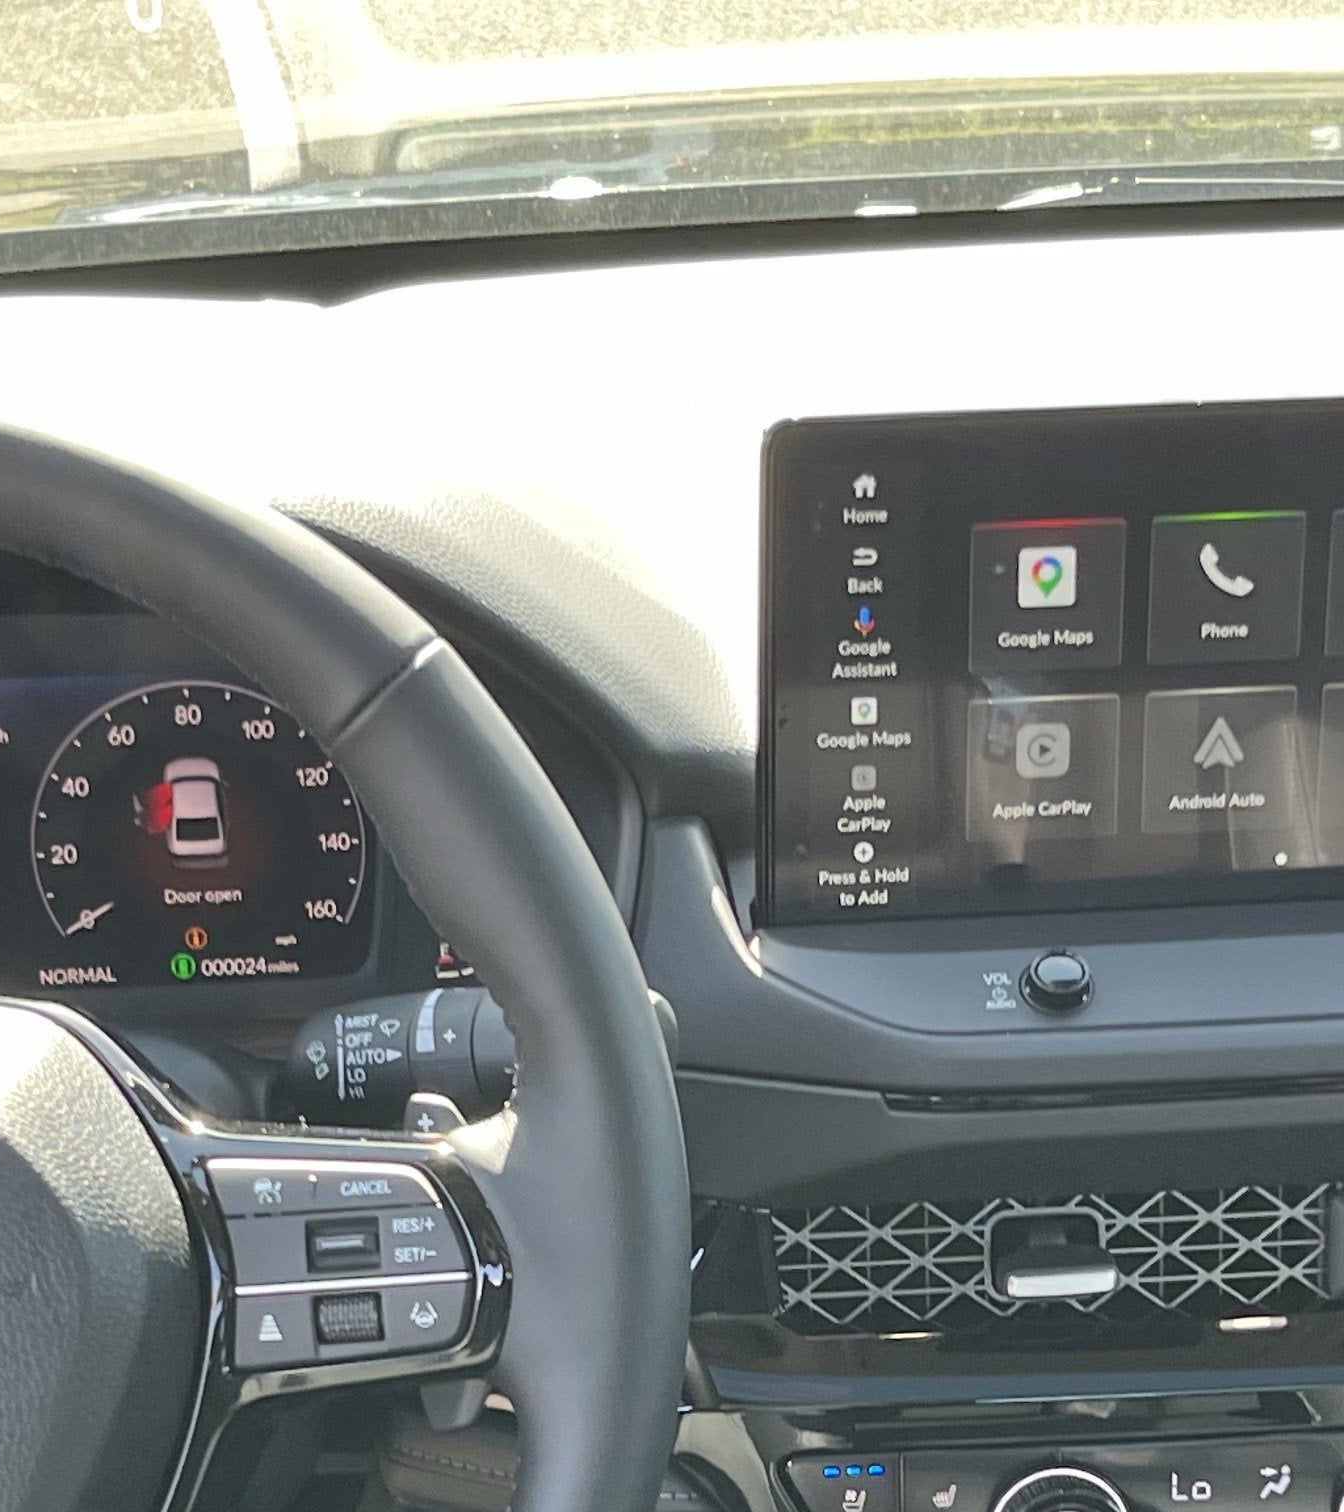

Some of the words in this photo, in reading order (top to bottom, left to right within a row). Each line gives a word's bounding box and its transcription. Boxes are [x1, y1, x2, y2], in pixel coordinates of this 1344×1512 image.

[843, 507, 887, 524] Home
[847, 577, 883, 594] Back
[998, 630, 1050, 650] Google
[1052, 627, 1093, 647] Maps
[1200, 622, 1248, 640] Phone
[838, 639, 890, 659] Google
[832, 660, 897, 678] Assistant
[175, 705, 201, 725] 80
[108, 726, 135, 746] 60
[242, 719, 274, 741] 100
[817, 731, 868, 750] Google
[872, 729, 911, 748] Maps
[62, 776, 89, 797] 40
[297, 766, 329, 788] 120
[843, 795, 886, 815] Apple
[992, 802, 1034, 821] Apple
[1038, 799, 1092, 819] CarPlay
[1169, 792, 1224, 811] Android
[1229, 791, 1265, 808] Auto
[837, 815, 891, 835] CarPlay
[318, 832, 350, 853] 140
[50, 845, 78, 865] 20
[818, 868, 855, 887] Press
[859, 868, 871, 884] &
[875, 865, 909, 884] Hold
[164, 888, 200, 903] Door
[204, 888, 242, 905] open
[839, 891, 854, 907] to
[856, 888, 888, 906] Add
[305, 900, 337, 920] 160
[39, 965, 117, 986] NORMAL
[201, 957, 266, 977] 000024
[267, 960, 300, 974] miles
[982, 972, 1012, 986] VOL
[344, 1031, 373, 1049] OFF
[345, 1049, 386, 1067] AUTO
[346, 1067, 367, 1084] LO
[339, 1180, 393, 1197] CANCEL
[1171, 1471, 1212, 1501] Lo
